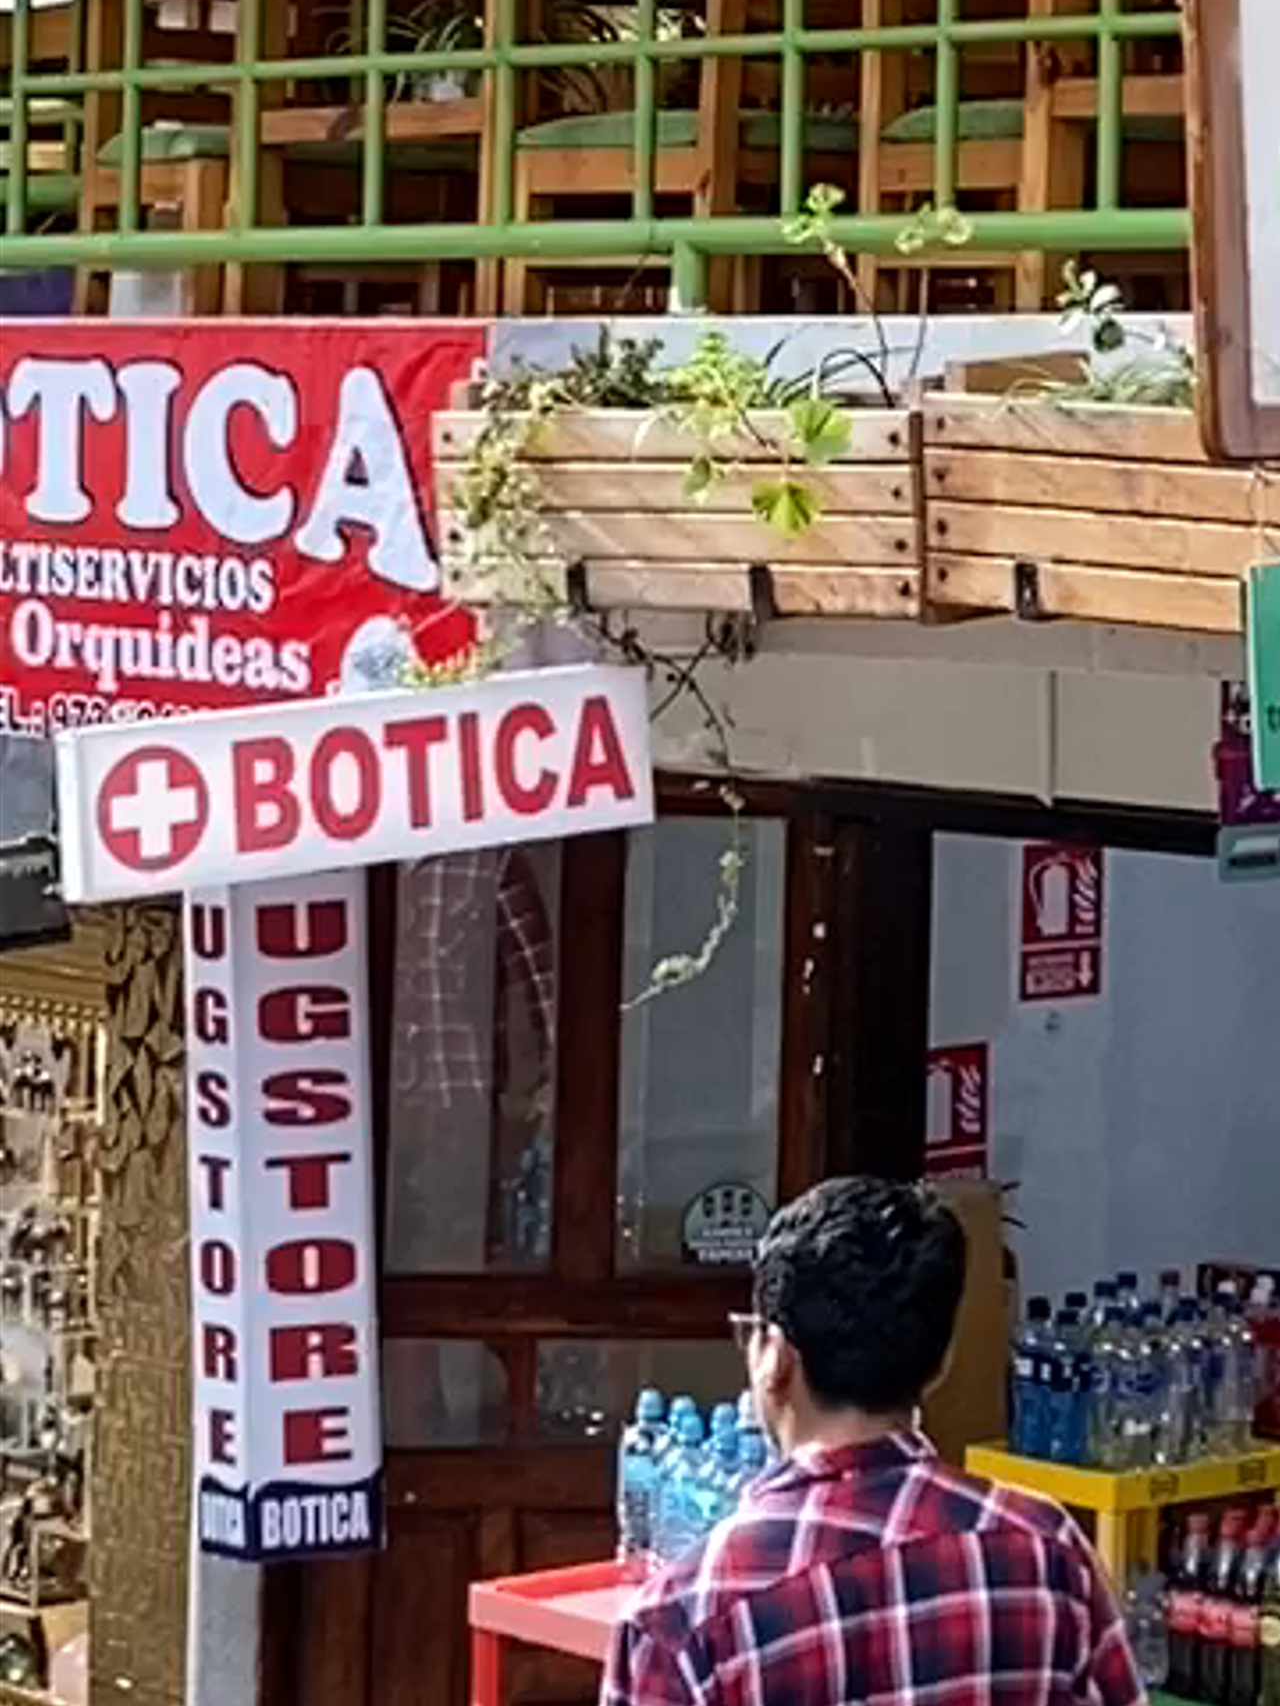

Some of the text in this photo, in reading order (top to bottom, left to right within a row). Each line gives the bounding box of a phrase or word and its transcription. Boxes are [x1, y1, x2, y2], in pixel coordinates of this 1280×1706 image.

[0, 357, 440, 593] TICA
[12, 599, 312, 693] Orquideas
[230, 694, 635, 853] BOTICA
[261, 1491, 370, 1550] BOTICA
